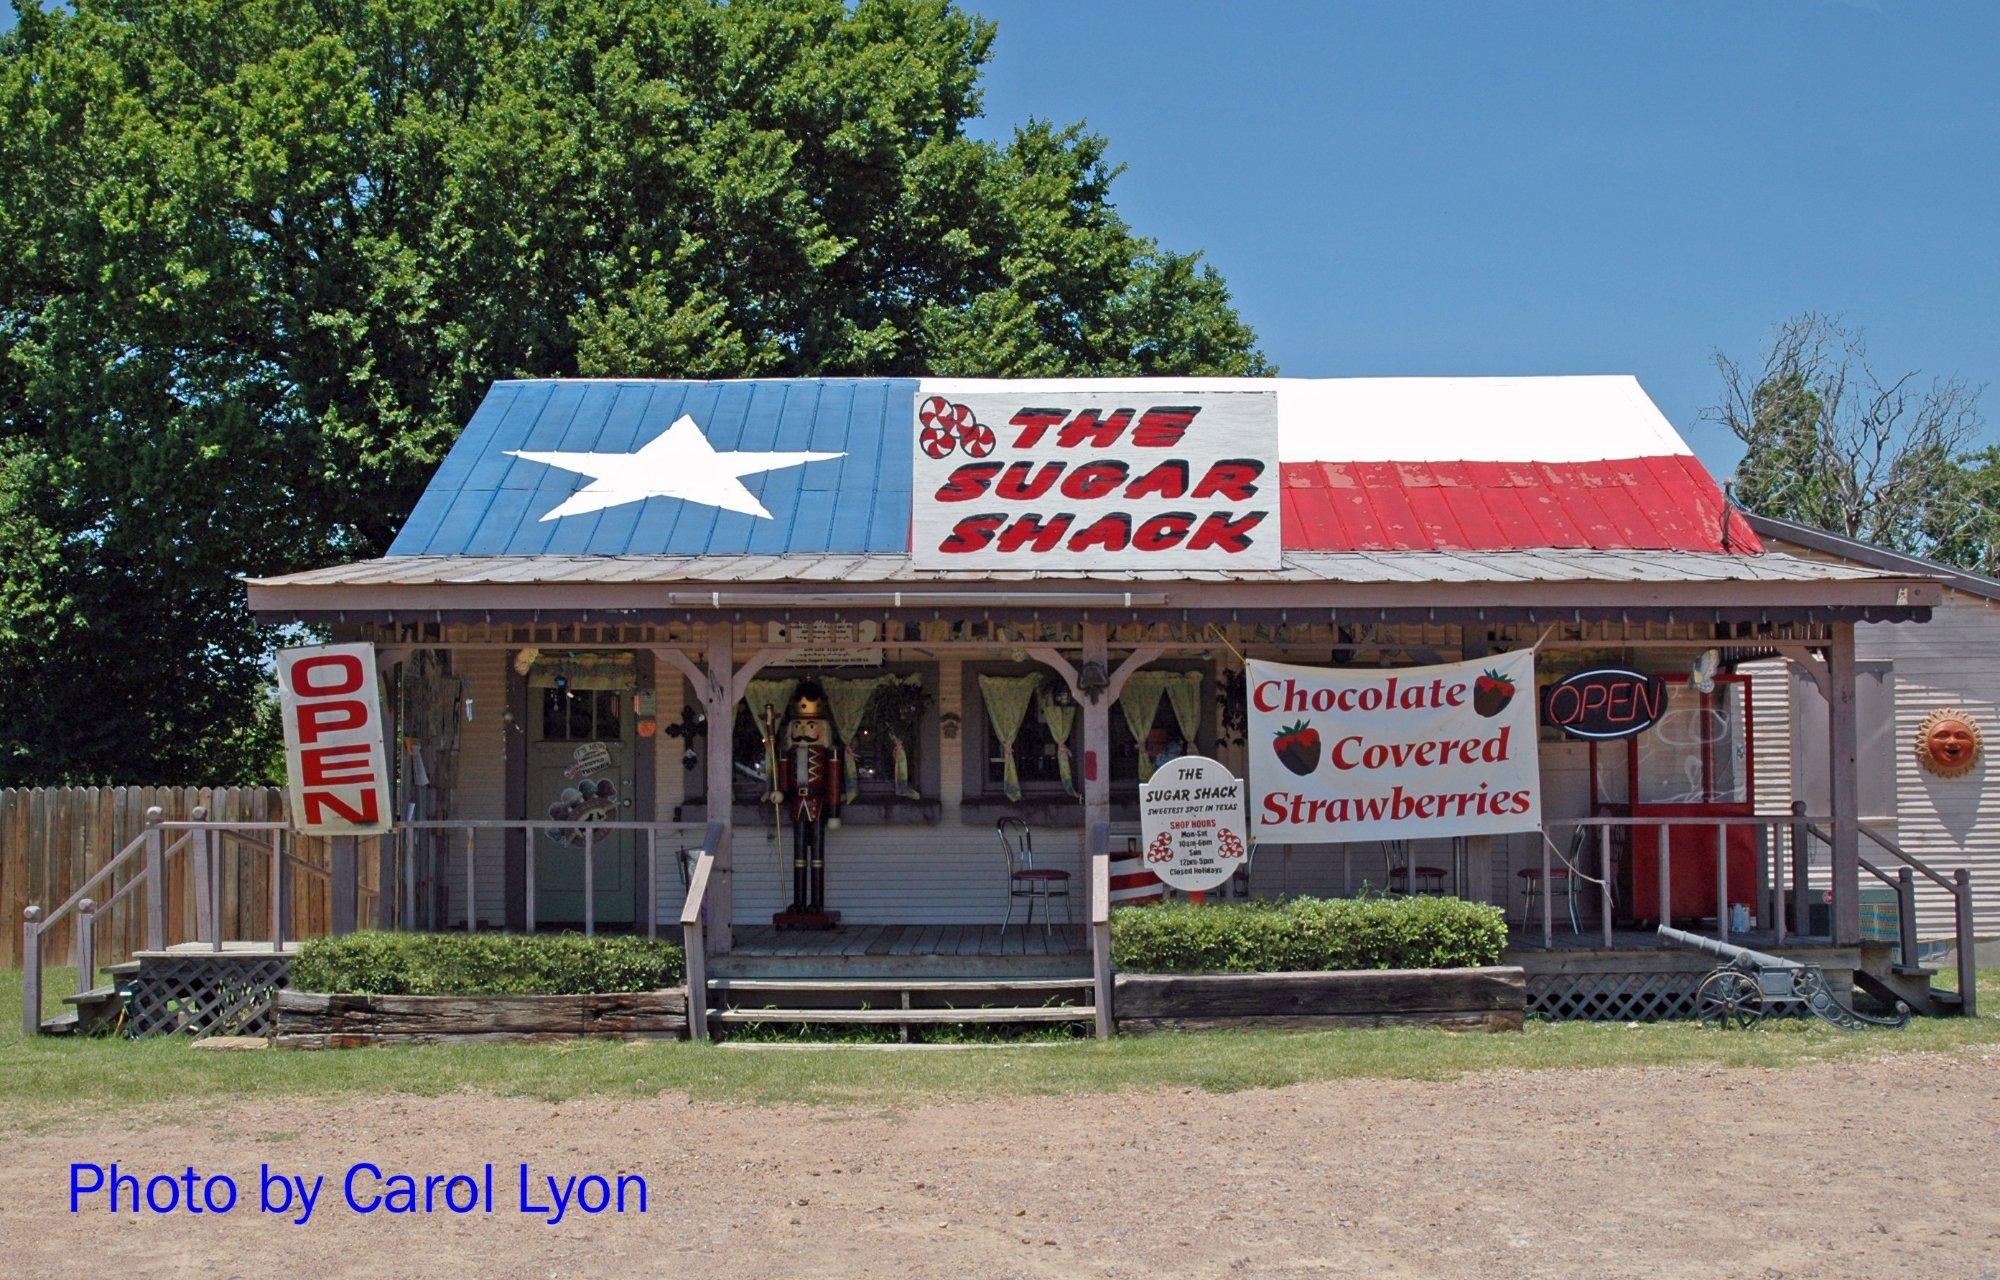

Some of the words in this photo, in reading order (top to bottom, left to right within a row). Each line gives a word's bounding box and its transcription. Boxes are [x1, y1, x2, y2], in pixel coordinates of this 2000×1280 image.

[1008, 405, 1203, 448] THE
[934, 458, 1266, 502] SUGAR
[938, 510, 1270, 553] SHACK
[1252, 677, 1467, 713] Chocolate
[1549, 682, 1661, 725] OPEN
[291, 654, 379, 825] OPEN
[1331, 726, 1511, 771] Covered
[1146, 789, 1190, 802] SUGAR
[1194, 786, 1238, 800] SHACK
[1178, 768, 1203, 781] THE
[1147, 807, 1184, 815] SWEETEST
[1185, 806, 1203, 814] SPOT
[1205, 804, 1213, 812] IN
[1216, 803, 1238, 811] TEXAS
[1170, 821, 1190, 830] SHOP
[1191, 819, 1216, 828] HOURS
[1260, 782, 1531, 826] Strawberries
[1169, 867, 1193, 876] Closed
[1193, 866, 1223, 875] Holidays
